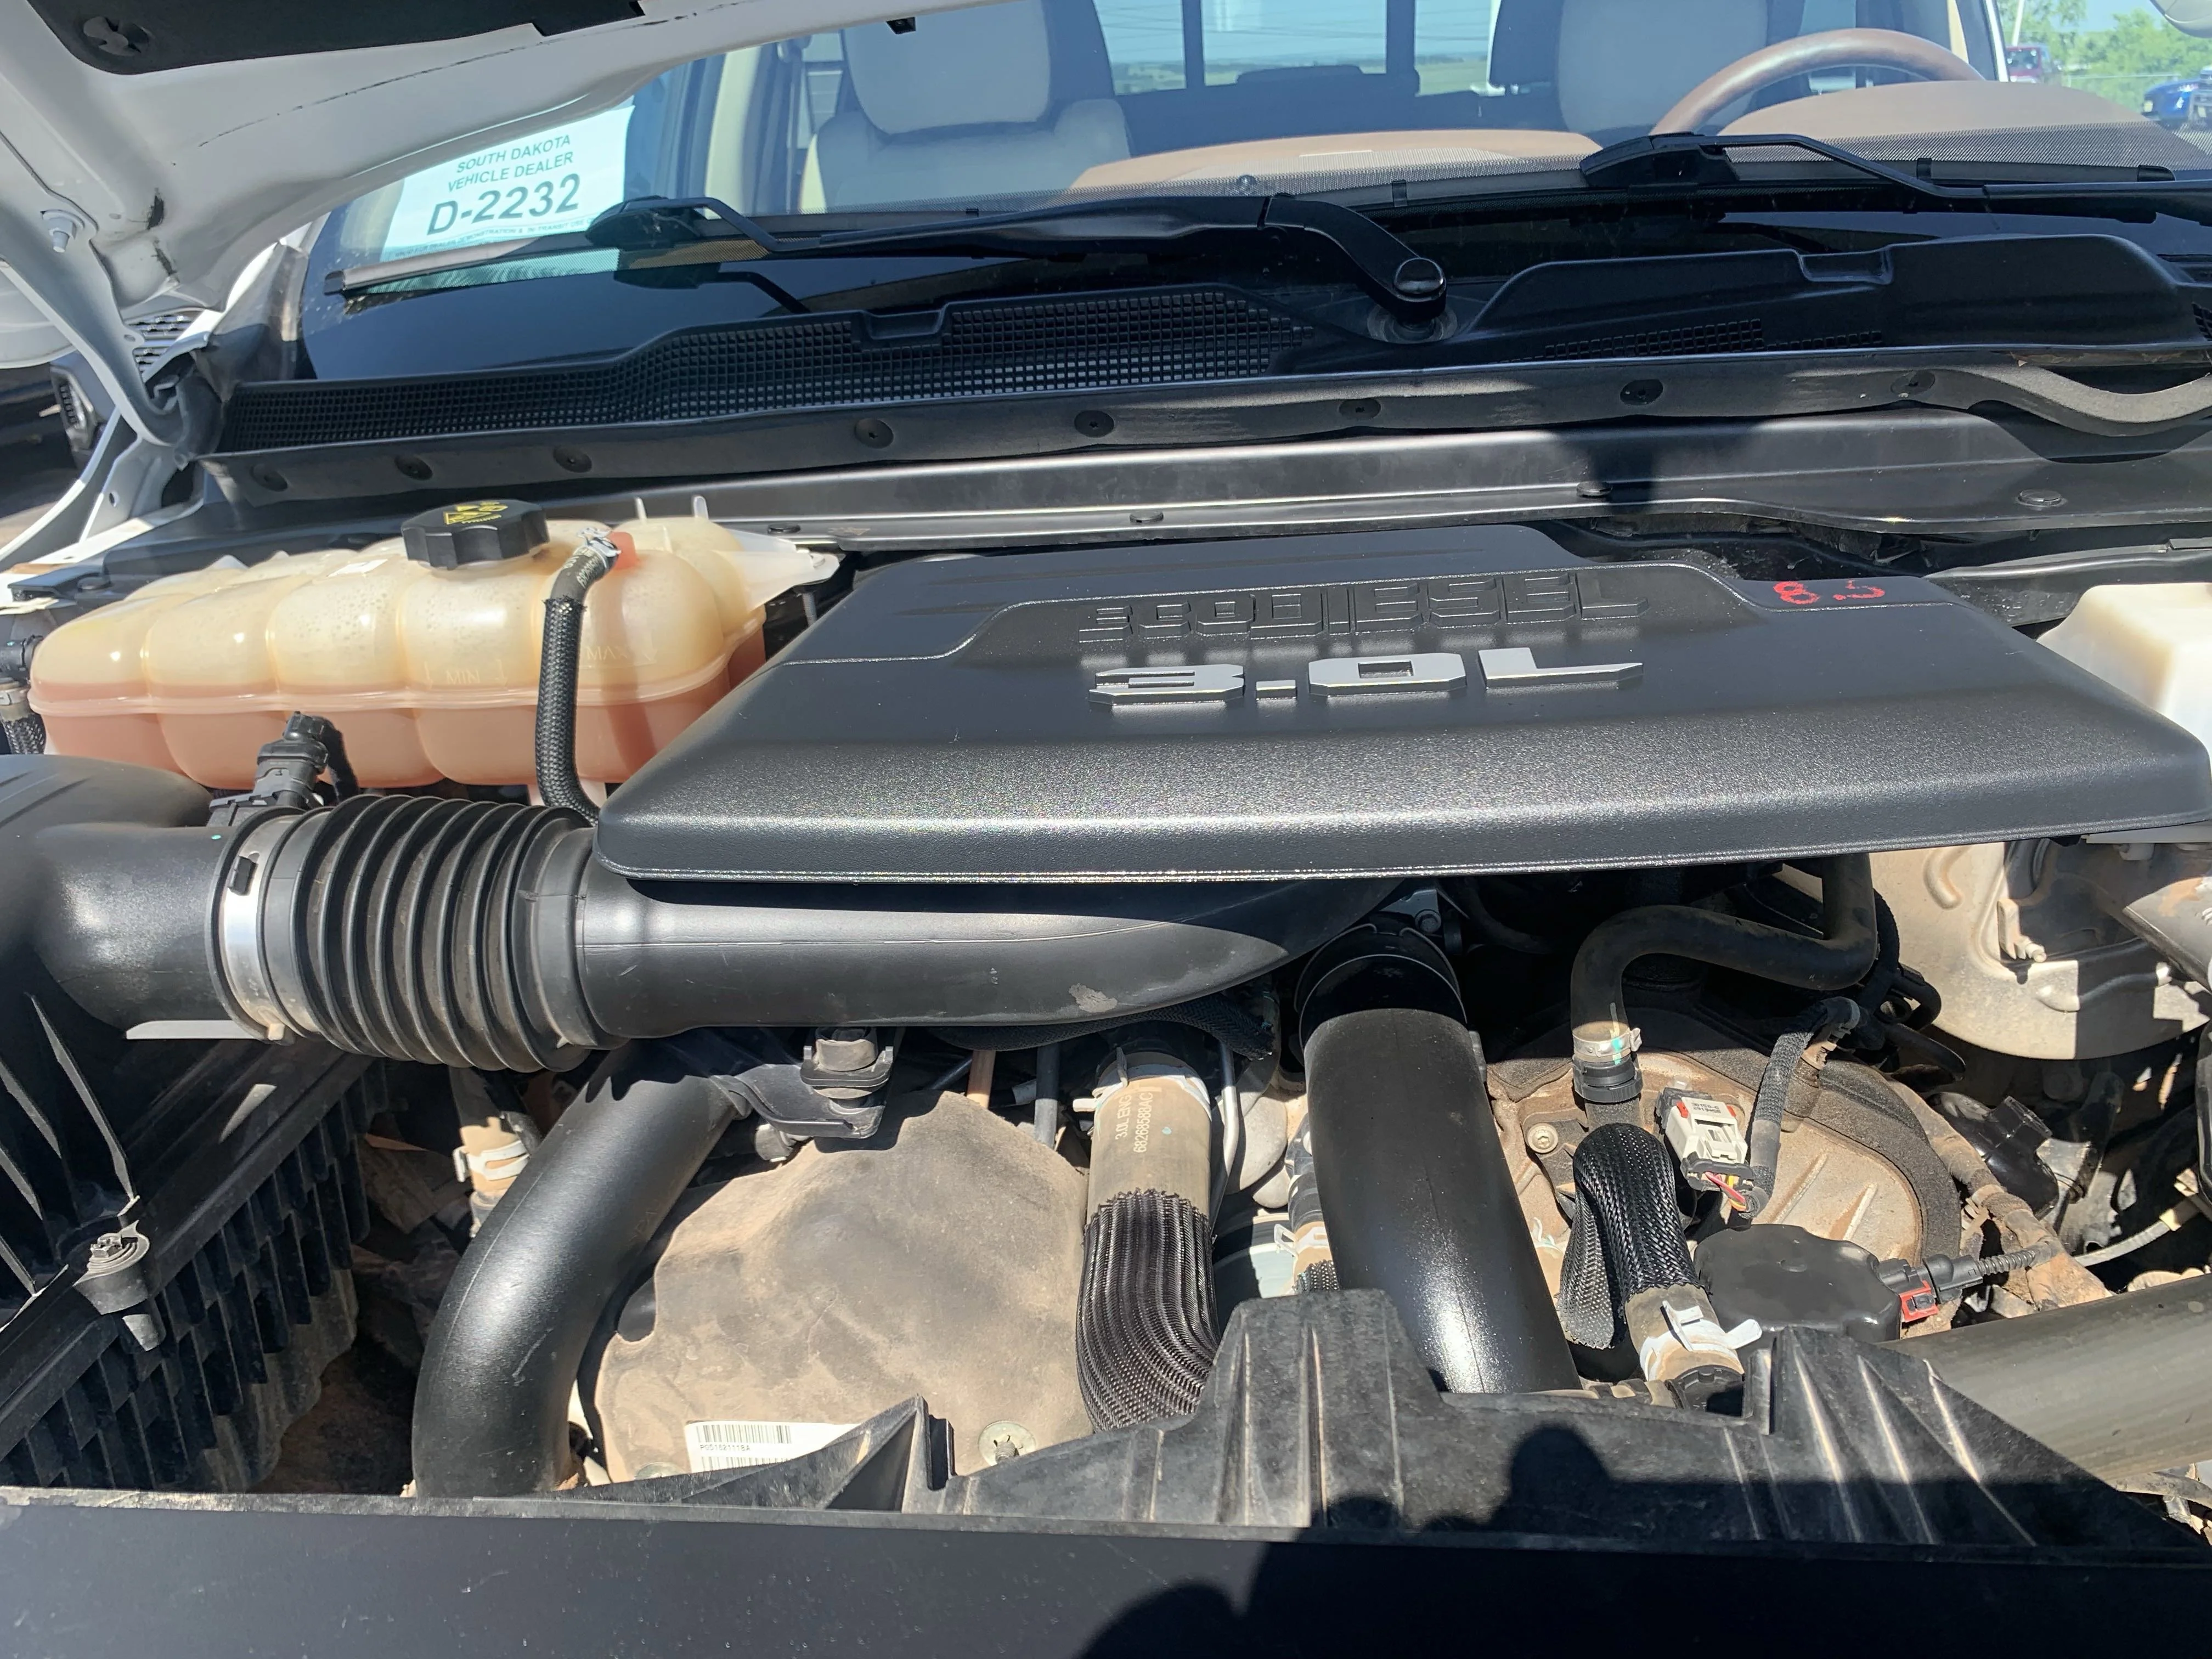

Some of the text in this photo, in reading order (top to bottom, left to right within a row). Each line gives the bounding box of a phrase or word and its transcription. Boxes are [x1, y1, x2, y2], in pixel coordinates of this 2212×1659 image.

[448, 151, 573, 193] VEHICLE DEALER
[456, 134, 571, 173] SOUTH DAKOTA
[427, 173, 580, 236] D-2232
[1078, 572, 1648, 643] ECODIESEL
[445, 670, 481, 685] MIN
[1088, 647, 1643, 704] 3.0L
